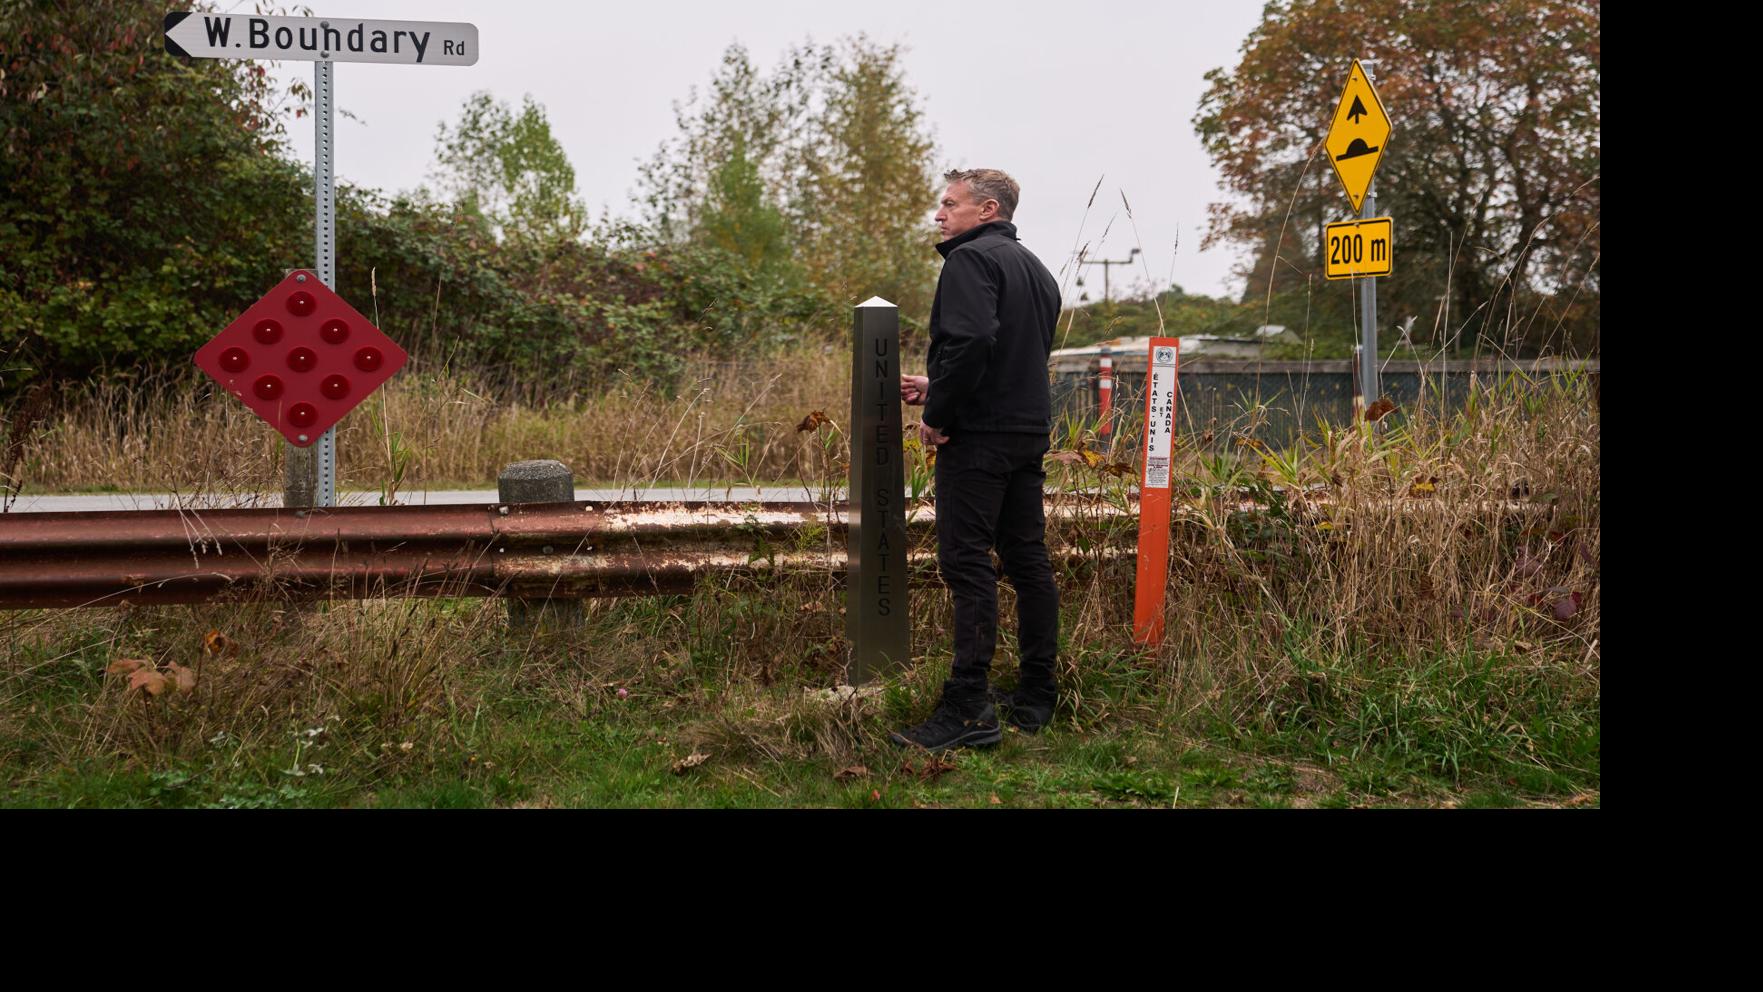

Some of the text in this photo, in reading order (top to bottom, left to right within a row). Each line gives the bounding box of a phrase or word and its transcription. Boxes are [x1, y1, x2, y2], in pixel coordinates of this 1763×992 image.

[443, 39, 466, 56] Rd
[1331, 234, 1386, 265] 200 m
[1160, 406, 1164, 417] ET
[1165, 391, 1173, 434] CANADA
[875, 338, 890, 617] UNITED STATES
